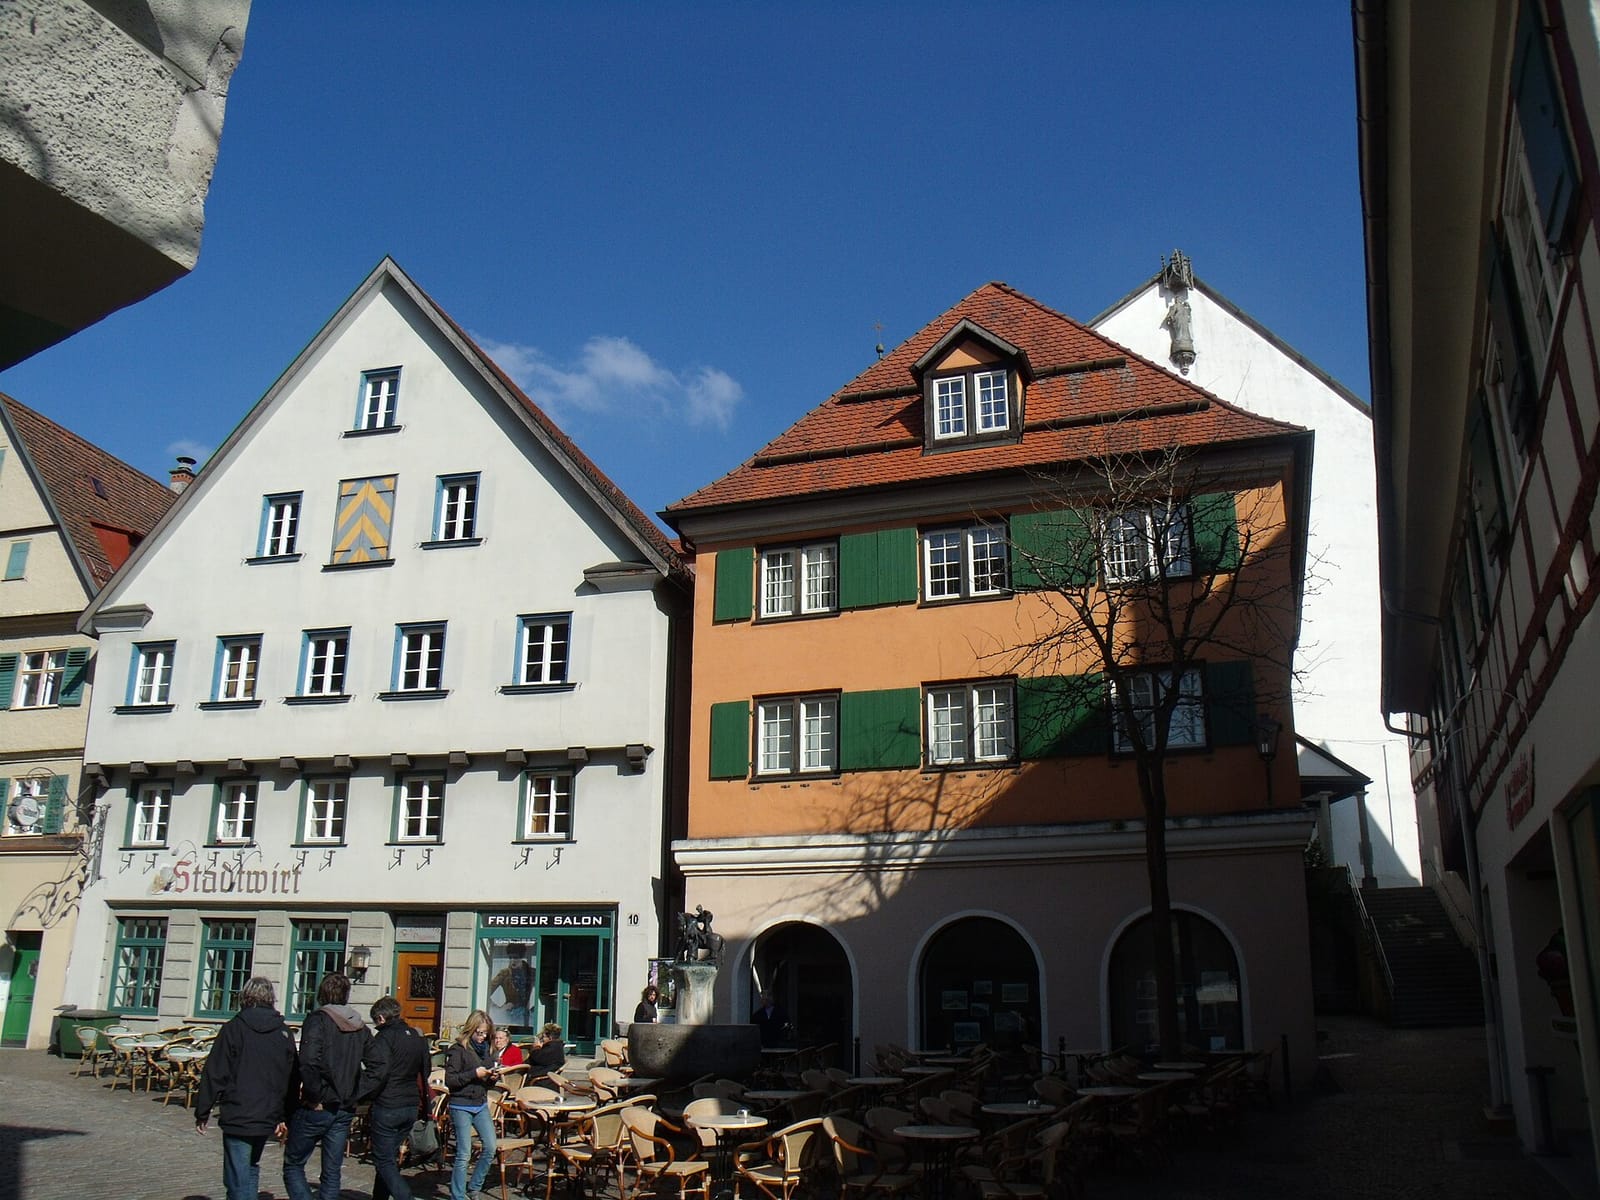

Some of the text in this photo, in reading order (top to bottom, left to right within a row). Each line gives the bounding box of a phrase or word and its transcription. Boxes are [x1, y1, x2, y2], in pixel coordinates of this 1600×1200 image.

[174, 861, 301, 893] Stadtwirt
[487, 915, 602, 925] FRISEUR SALON
[628, 914, 639, 925] 10
